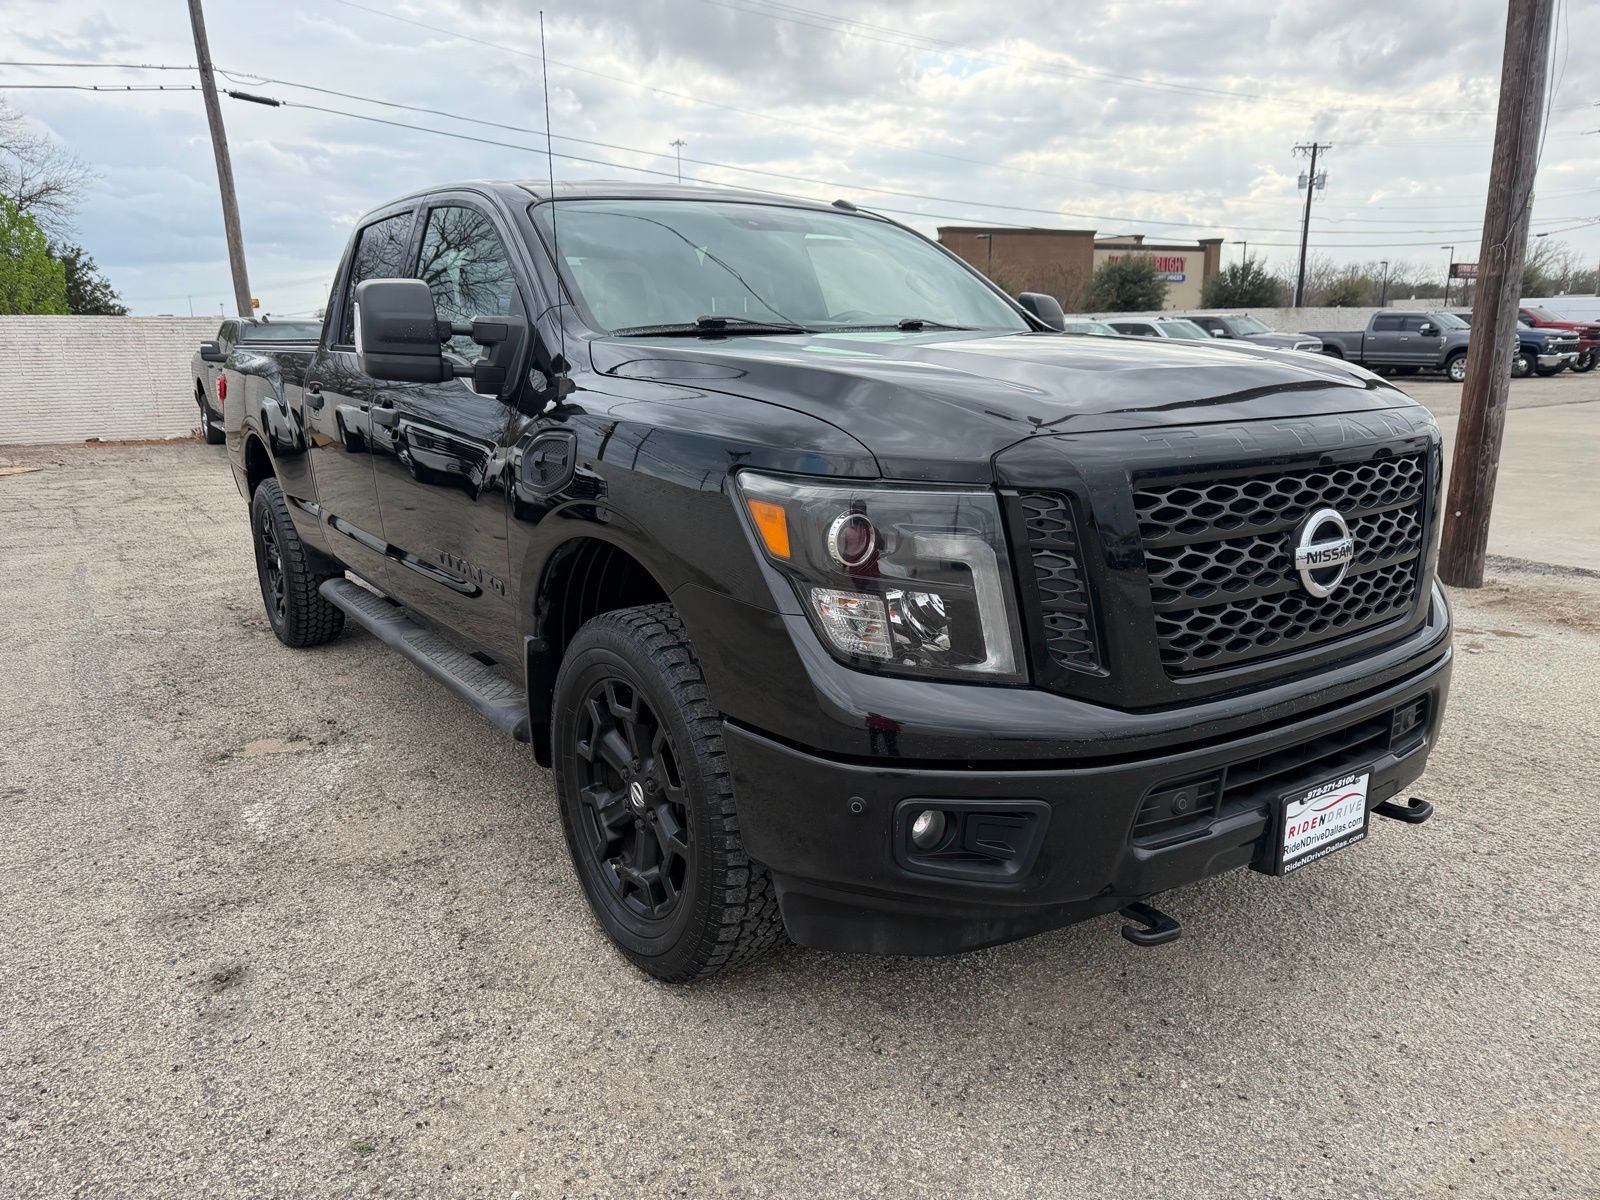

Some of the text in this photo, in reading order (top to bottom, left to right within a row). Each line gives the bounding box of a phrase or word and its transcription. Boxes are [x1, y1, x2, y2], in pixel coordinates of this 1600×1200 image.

[1306, 546, 1353, 564] NISSAN
[1307, 774, 1356, 800] 972-271-5100
[1284, 816, 1363, 856] RideNDriveDallas.com
[1288, 799, 1363, 839] RIDENDRIVE
[1284, 833, 1364, 873] RideNDriveDallas.com
